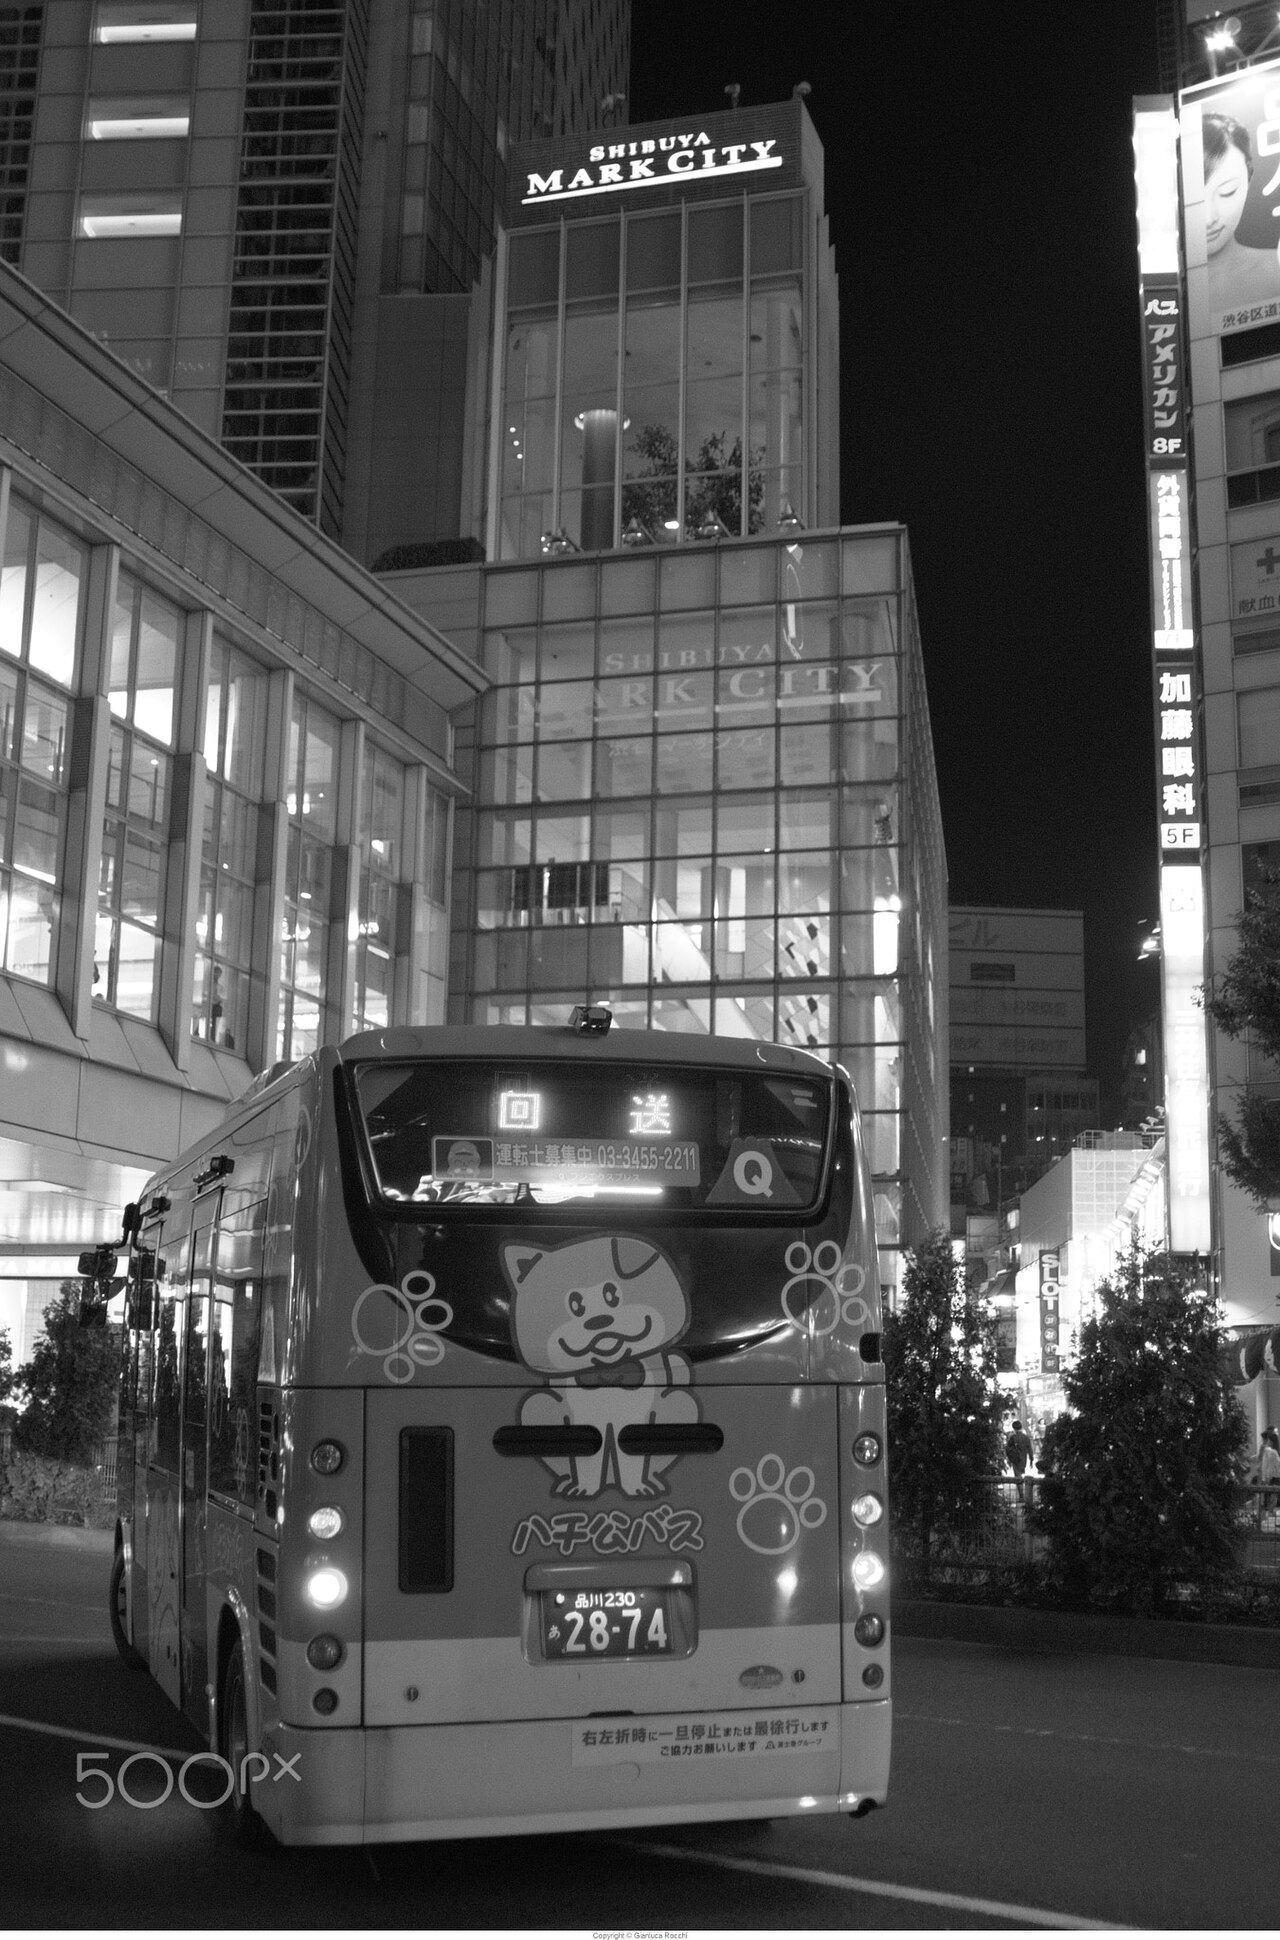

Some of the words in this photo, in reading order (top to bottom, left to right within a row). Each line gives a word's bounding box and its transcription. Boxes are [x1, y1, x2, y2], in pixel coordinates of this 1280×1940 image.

[590, 132, 711, 162] SHIBUYA
[527, 157, 655, 195] MARK
[667, 140, 777, 174] CITY
[1222, 302, 1280, 330] 渋谷区道
[1147, 323, 1179, 429] アメリカン
[1152, 437, 1181, 454] 8F
[1239, 594, 1280, 615] 献血
[604, 643, 773, 674] SHIBUYA
[729, 662, 884, 699] CITY
[1159, 673, 1196, 816] 加藤眼科
[1166, 828, 1194, 844] 5F
[496, 1143, 592, 1169] 運転士募集中
[597, 1145, 696, 1171] 03-3455-2211
[733, 1150, 773, 1197] Q
[1041, 1253, 1060, 1311] SLOT
[512, 1504, 704, 1555] ハチ公バス
[564, 1608, 667, 1652] 28-74
[660, 1741, 757, 1757] ご協力お願いします
